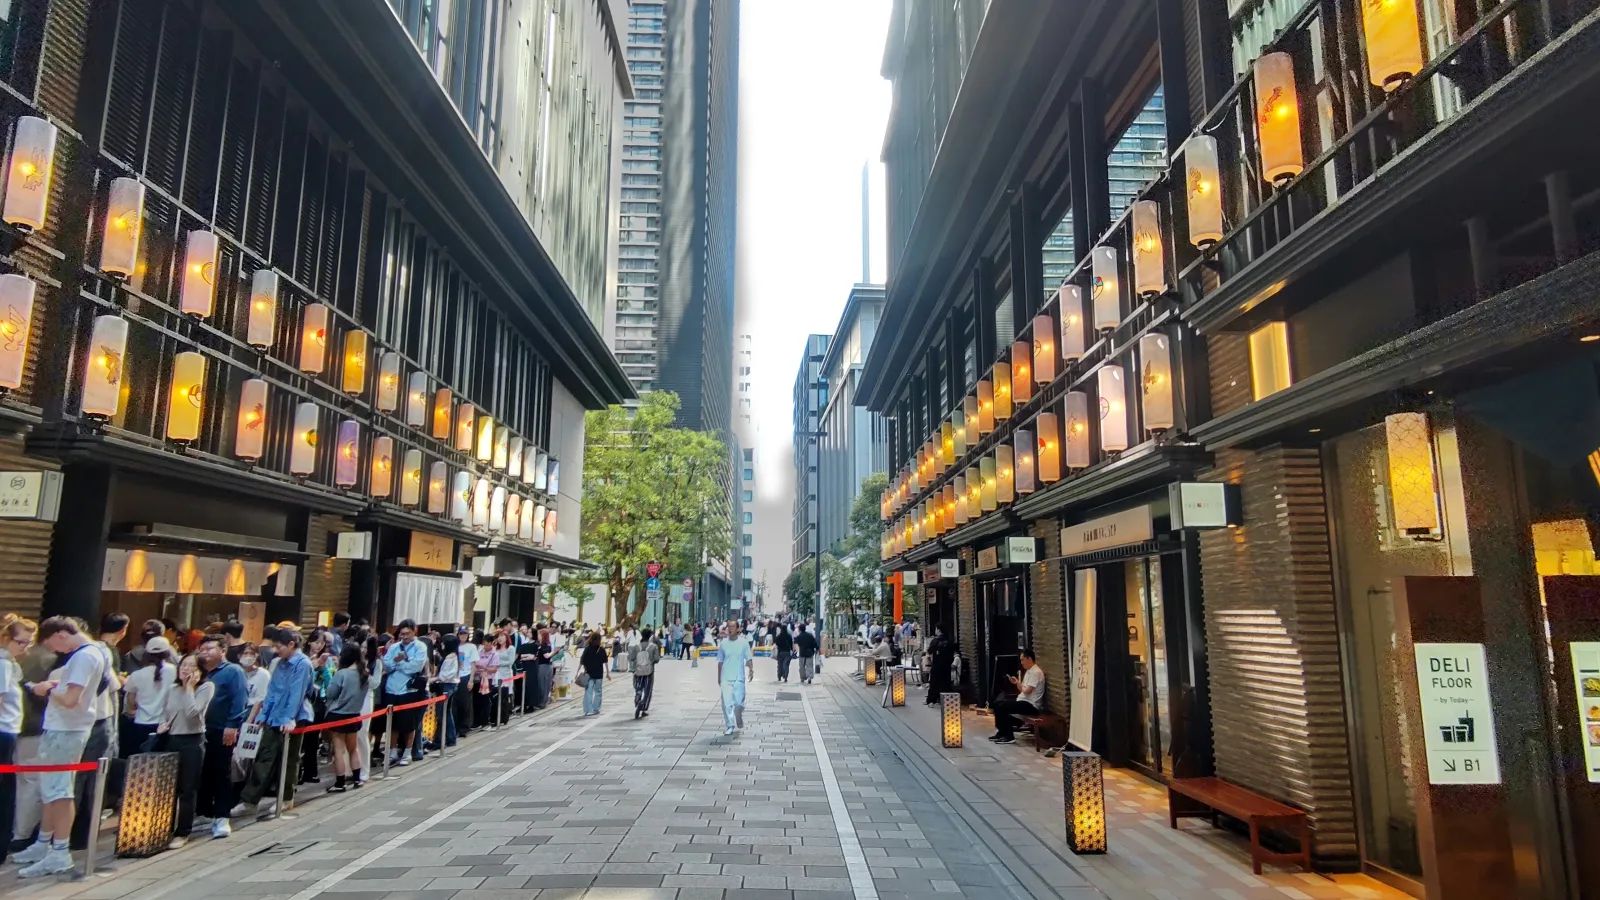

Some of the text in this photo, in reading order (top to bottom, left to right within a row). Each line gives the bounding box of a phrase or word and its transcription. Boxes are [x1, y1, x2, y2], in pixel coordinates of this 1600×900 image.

[1430, 658, 1470, 673] DELI
[1432, 678, 1473, 688] FLOOR
[1464, 759, 1480, 771] B1
